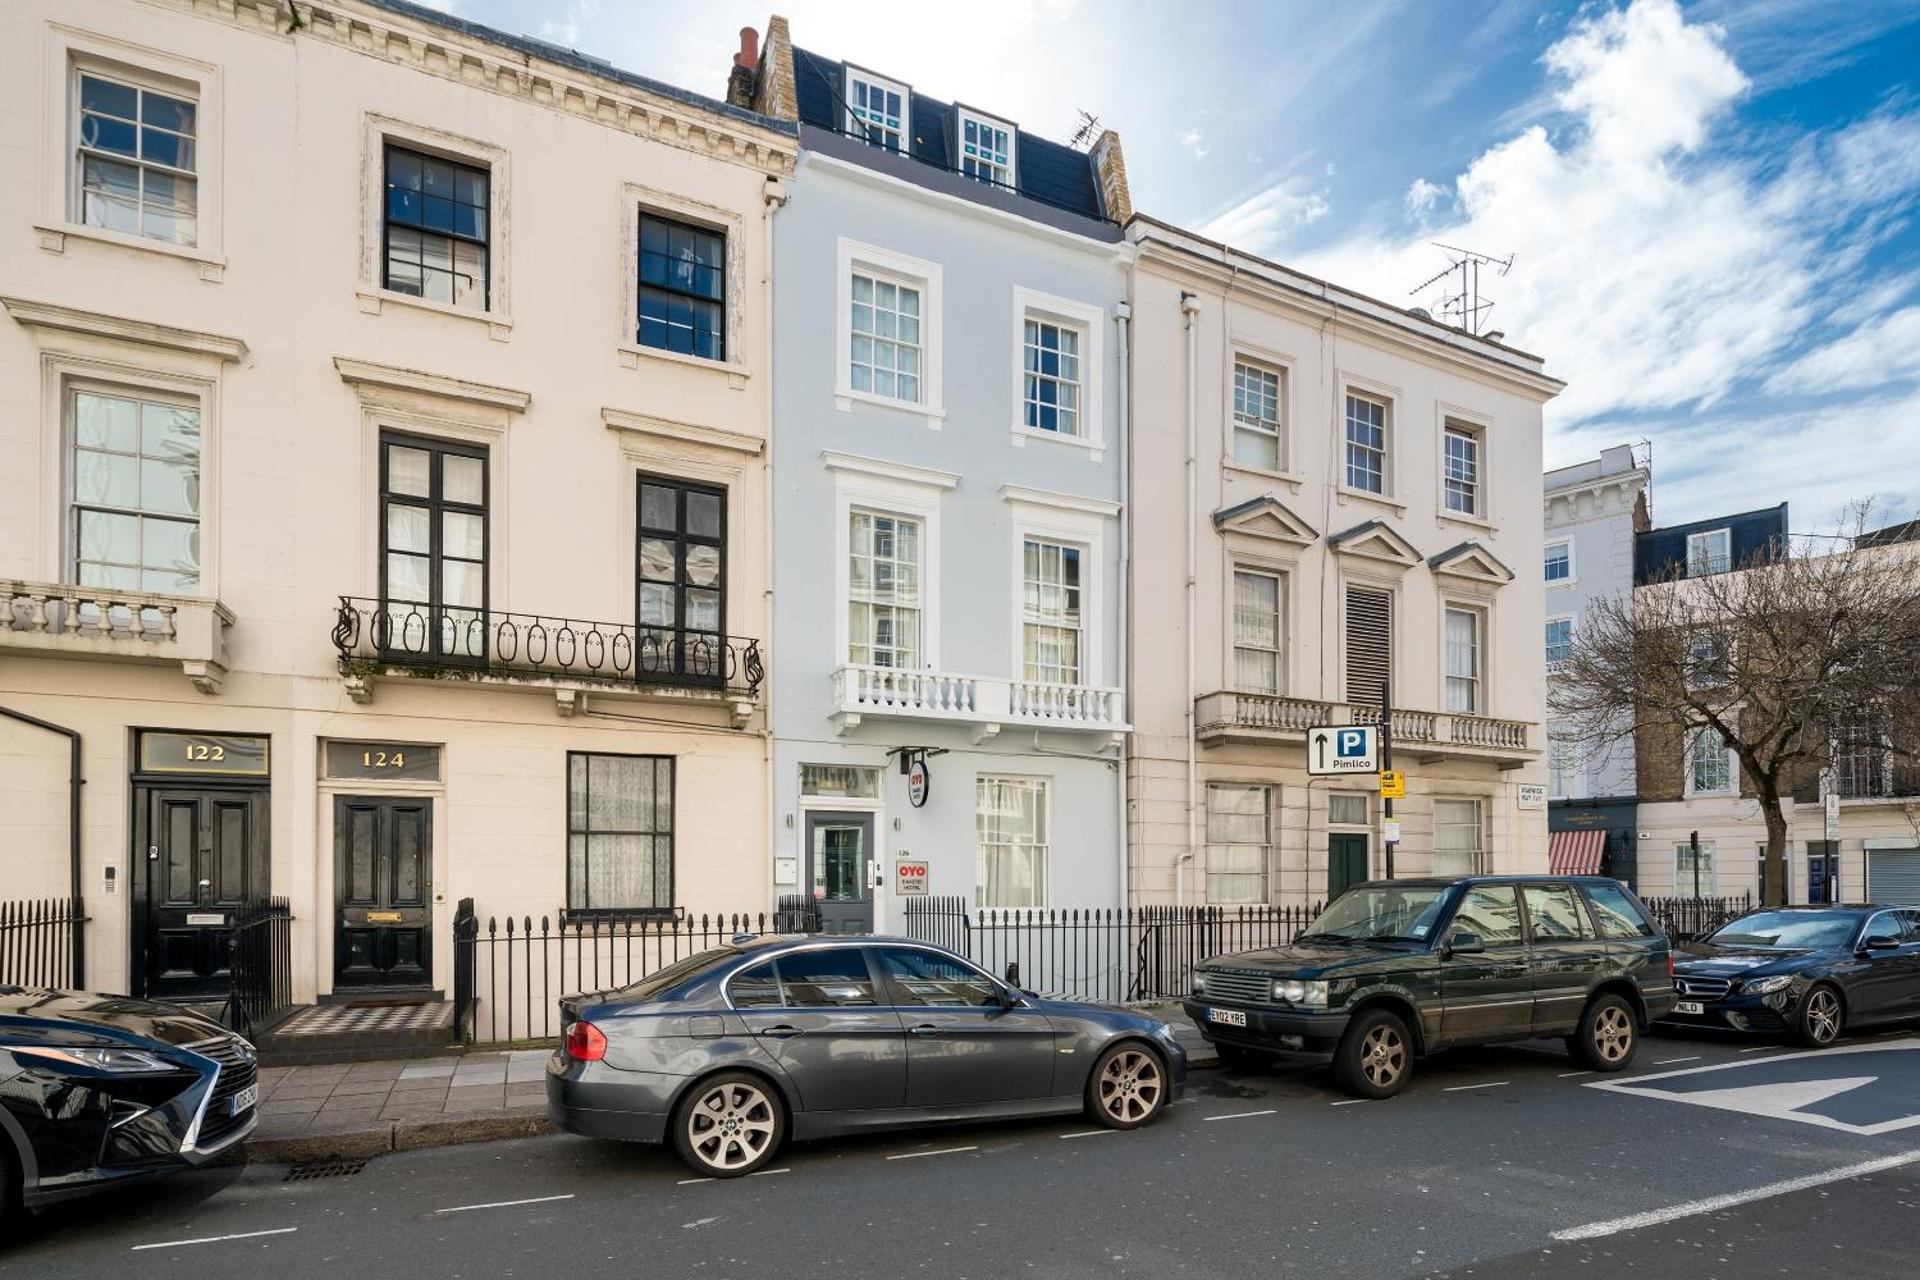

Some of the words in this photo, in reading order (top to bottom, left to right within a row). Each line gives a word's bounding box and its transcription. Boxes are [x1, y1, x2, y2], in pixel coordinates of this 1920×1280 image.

[1343, 732, 1361, 755] P
[186, 745, 225, 761] 122
[363, 752, 405, 768] 124
[1333, 760, 1371, 768] Pimlico
[900, 866, 925, 876] OYO
